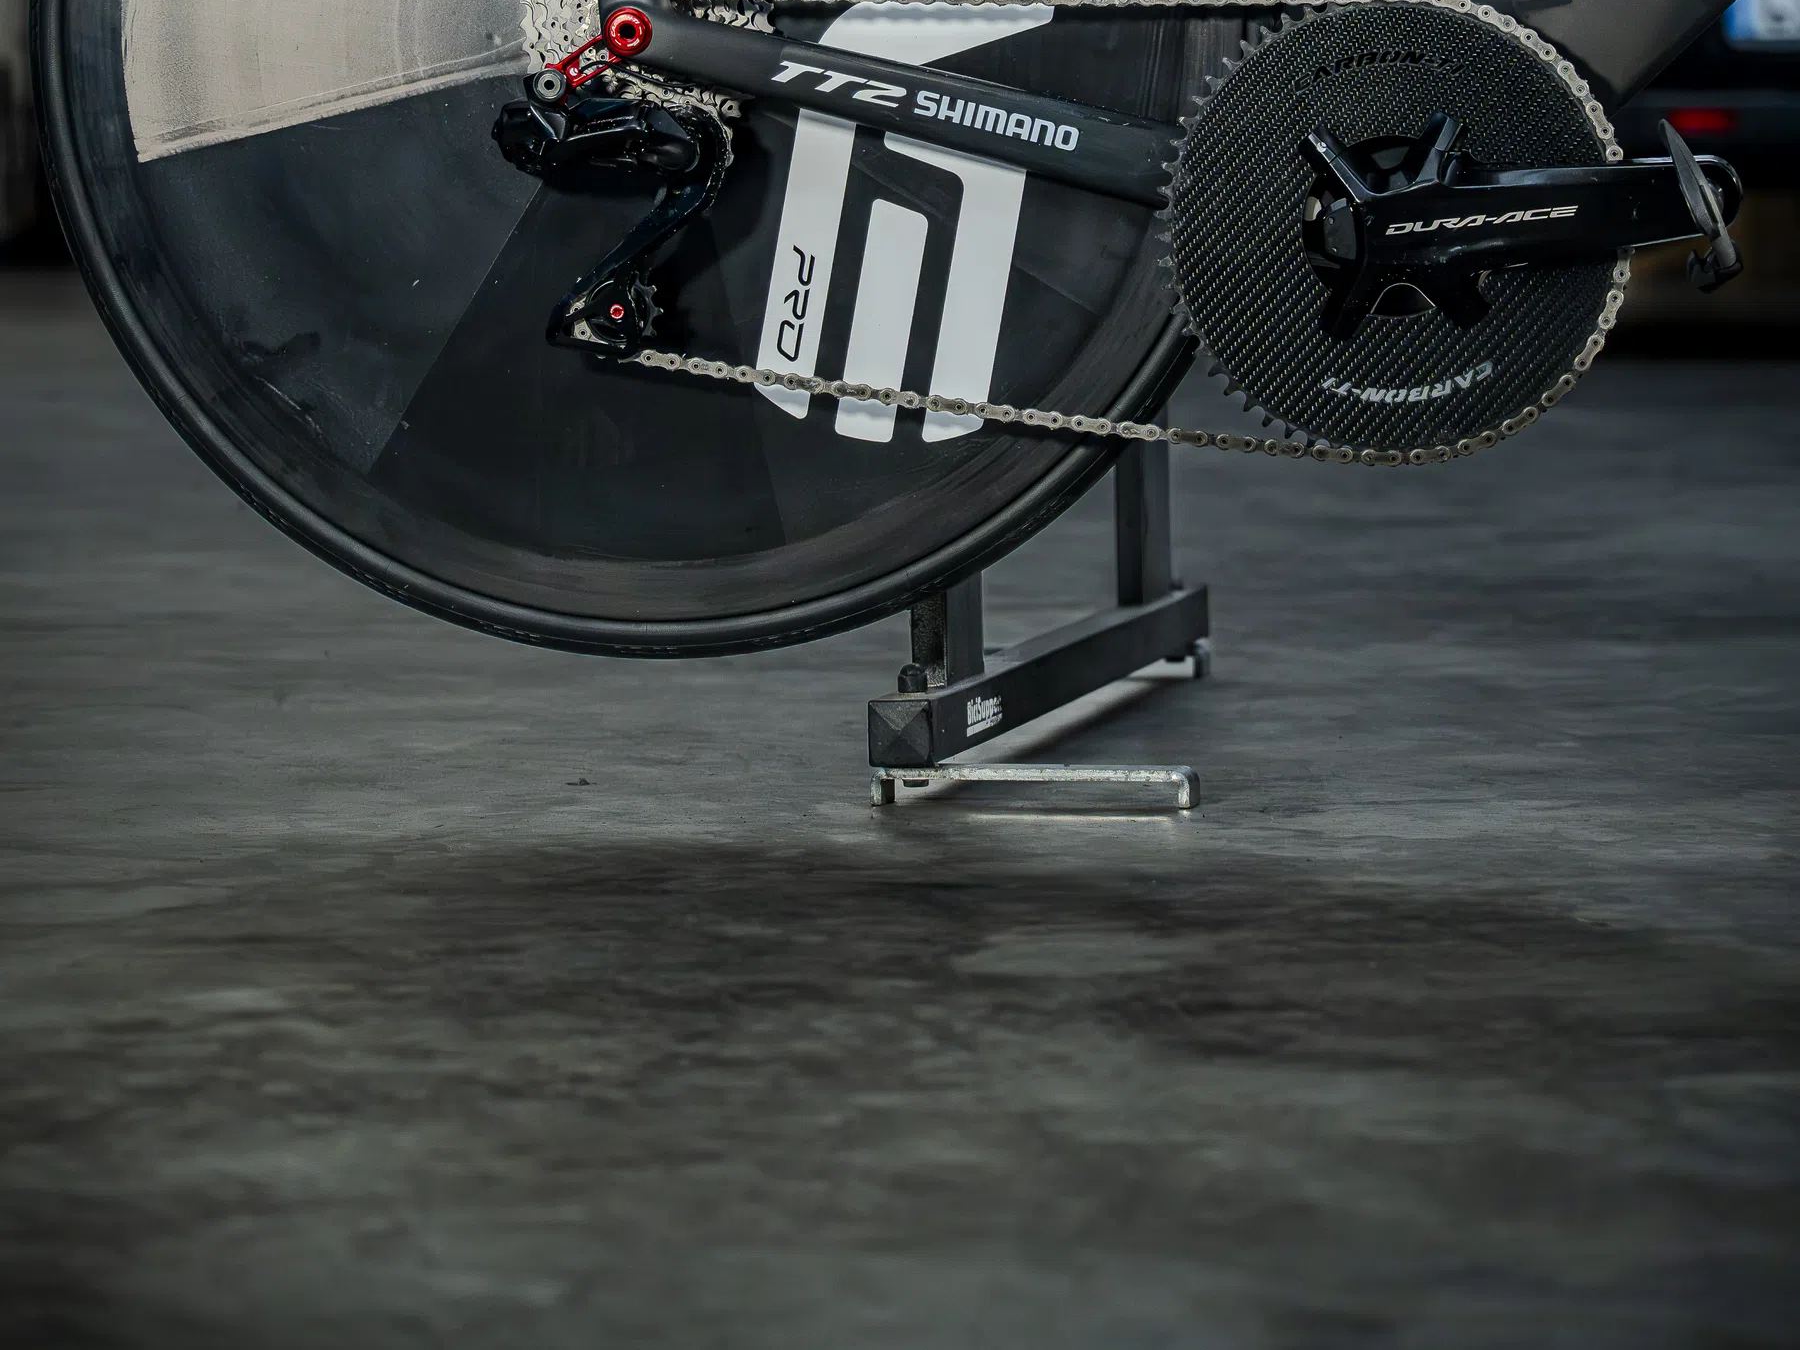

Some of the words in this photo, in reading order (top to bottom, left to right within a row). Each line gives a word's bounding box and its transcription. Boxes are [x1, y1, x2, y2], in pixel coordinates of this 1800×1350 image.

[1293, 49, 1467, 95] CARBON-TI
[770, 59, 908, 109] TT2
[913, 90, 1081, 152] SHIMANO
[1385, 204, 1579, 237] DURA-ACE
[775, 243, 817, 363] PRO
[1321, 359, 1494, 405] CARBON-TI
